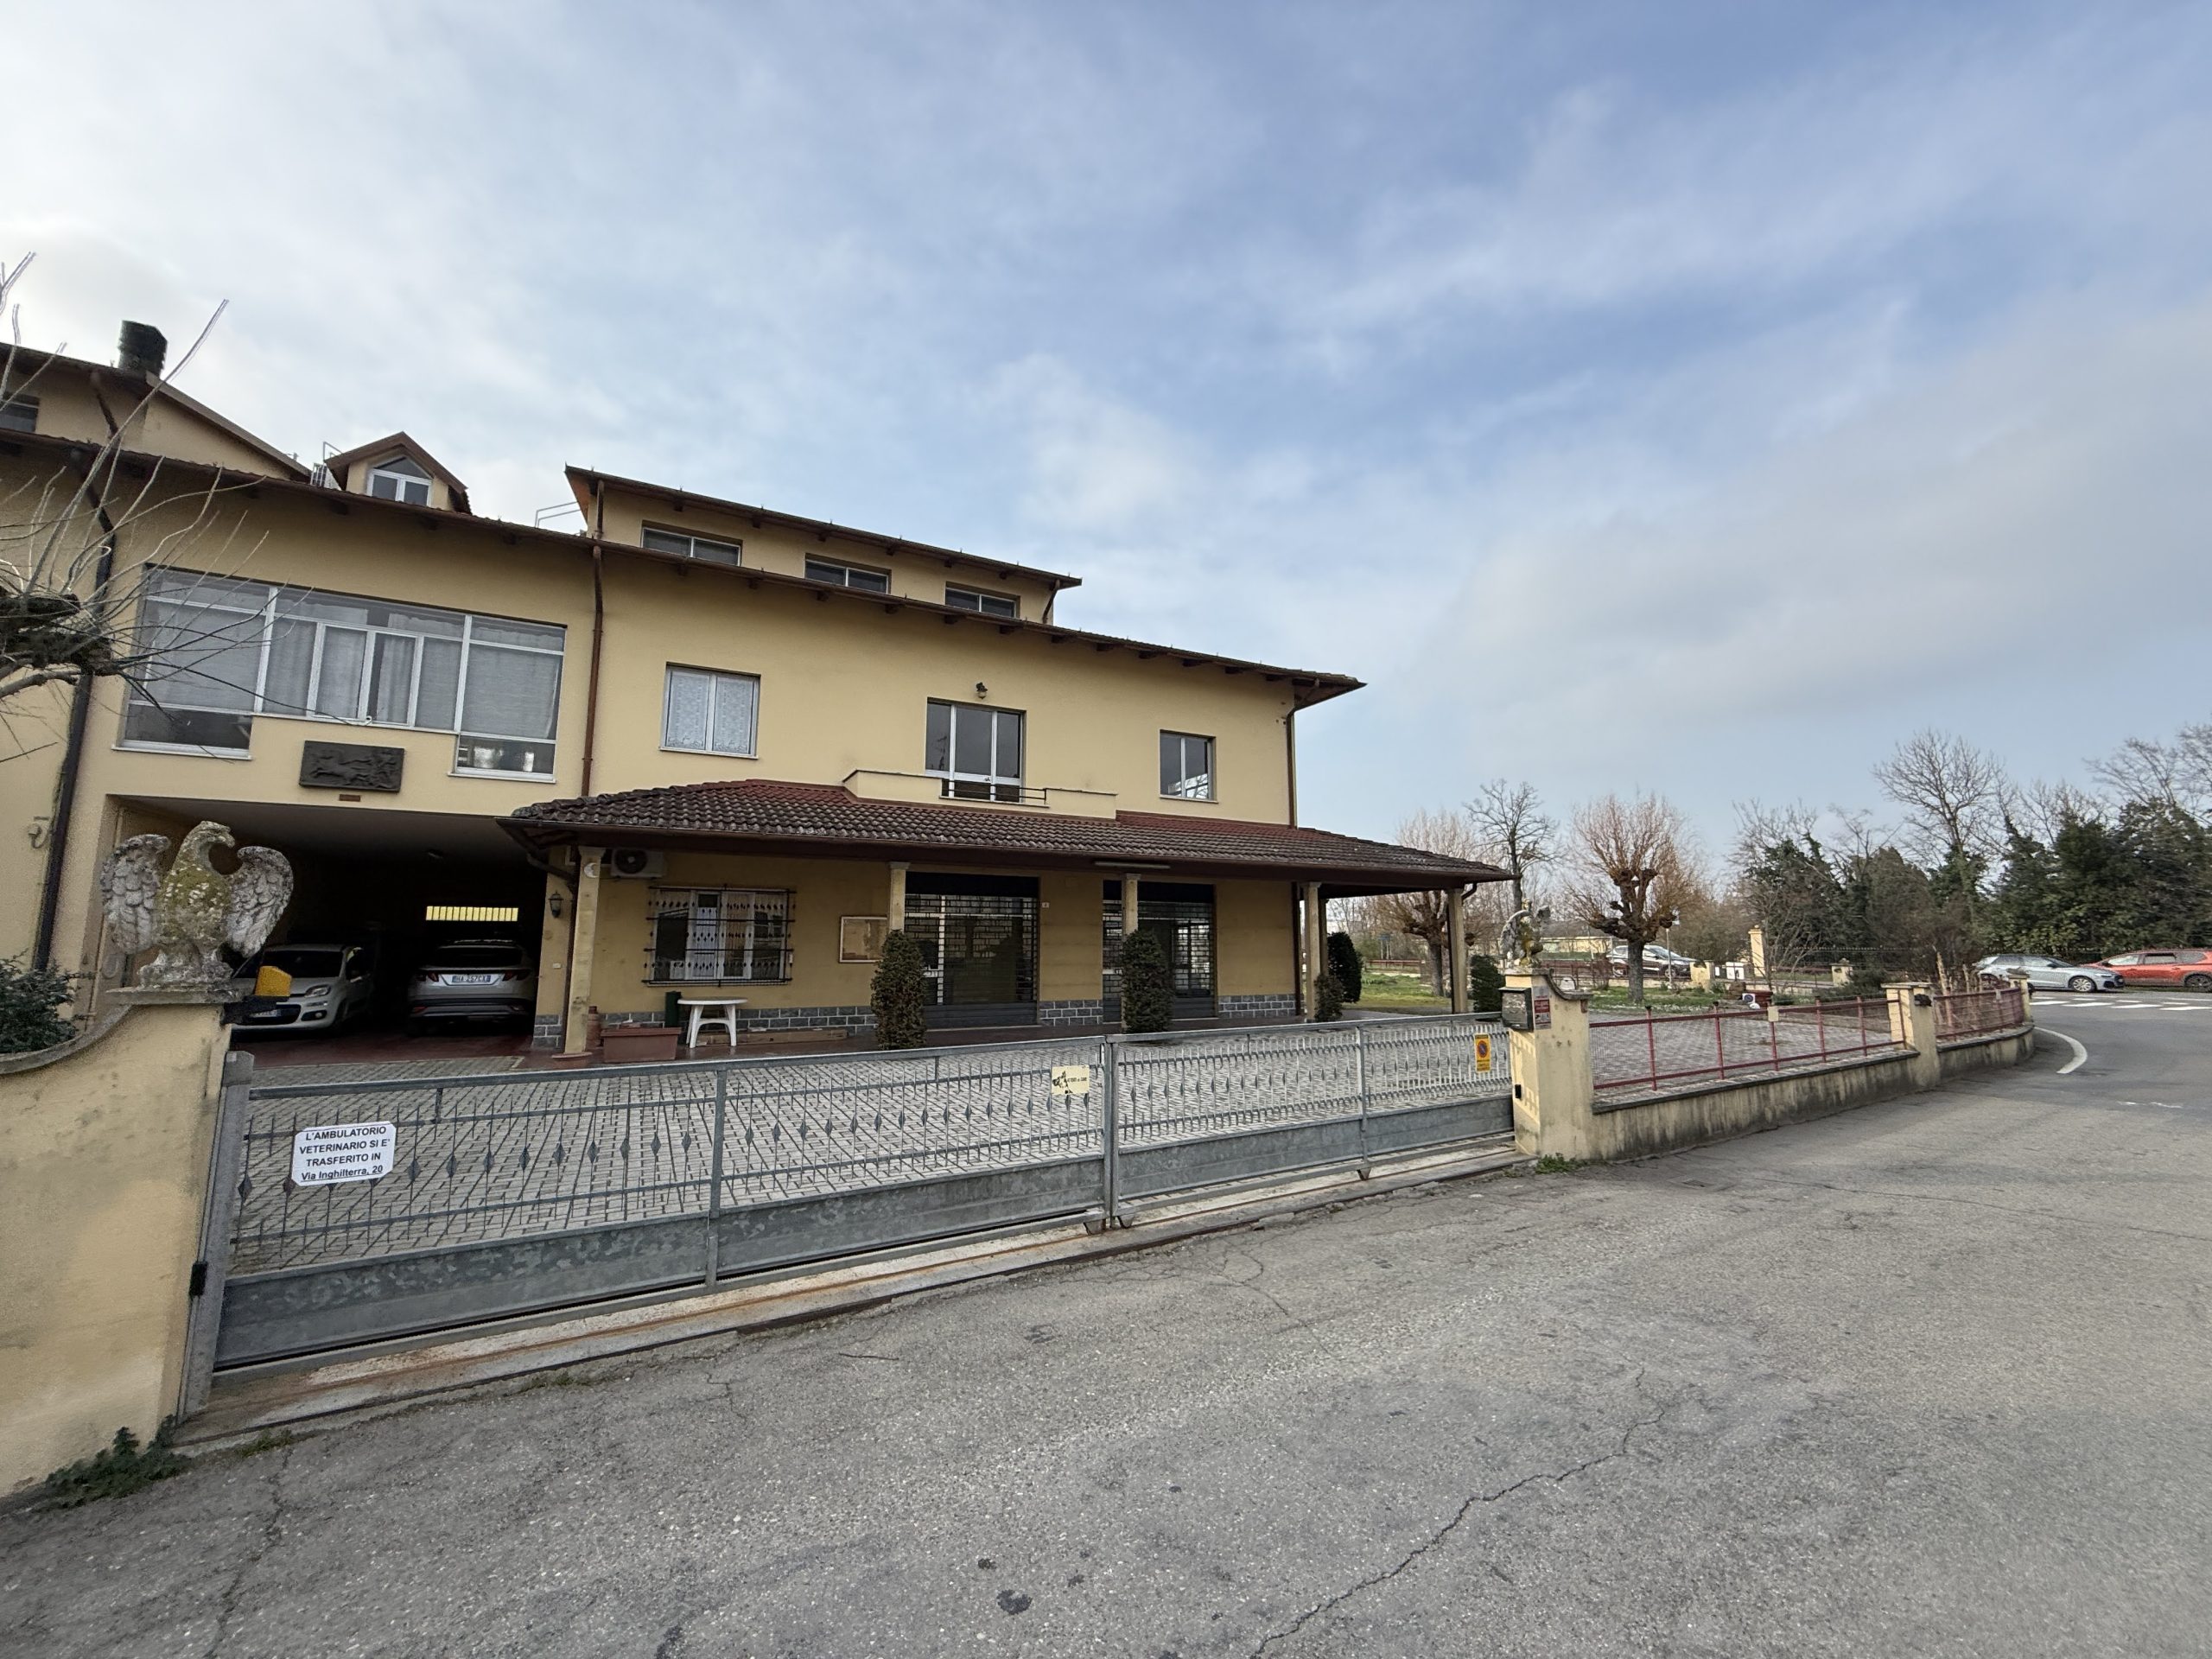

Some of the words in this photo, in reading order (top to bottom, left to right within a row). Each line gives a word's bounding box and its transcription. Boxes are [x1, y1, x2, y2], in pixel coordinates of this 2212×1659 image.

[305, 1126, 386, 1141] L'AMBULATORIO
[300, 1141, 366, 1154] VETERINARIO
[369, 1139, 378, 1148] SI
[381, 1139, 390, 1147] E'
[306, 1154, 369, 1166] TRASFERITO
[371, 1152, 381, 1160] IN
[301, 1172, 316, 1180] Via
[318, 1167, 370, 1179] Inghilterra,
[372, 1165, 384, 1173] 20
